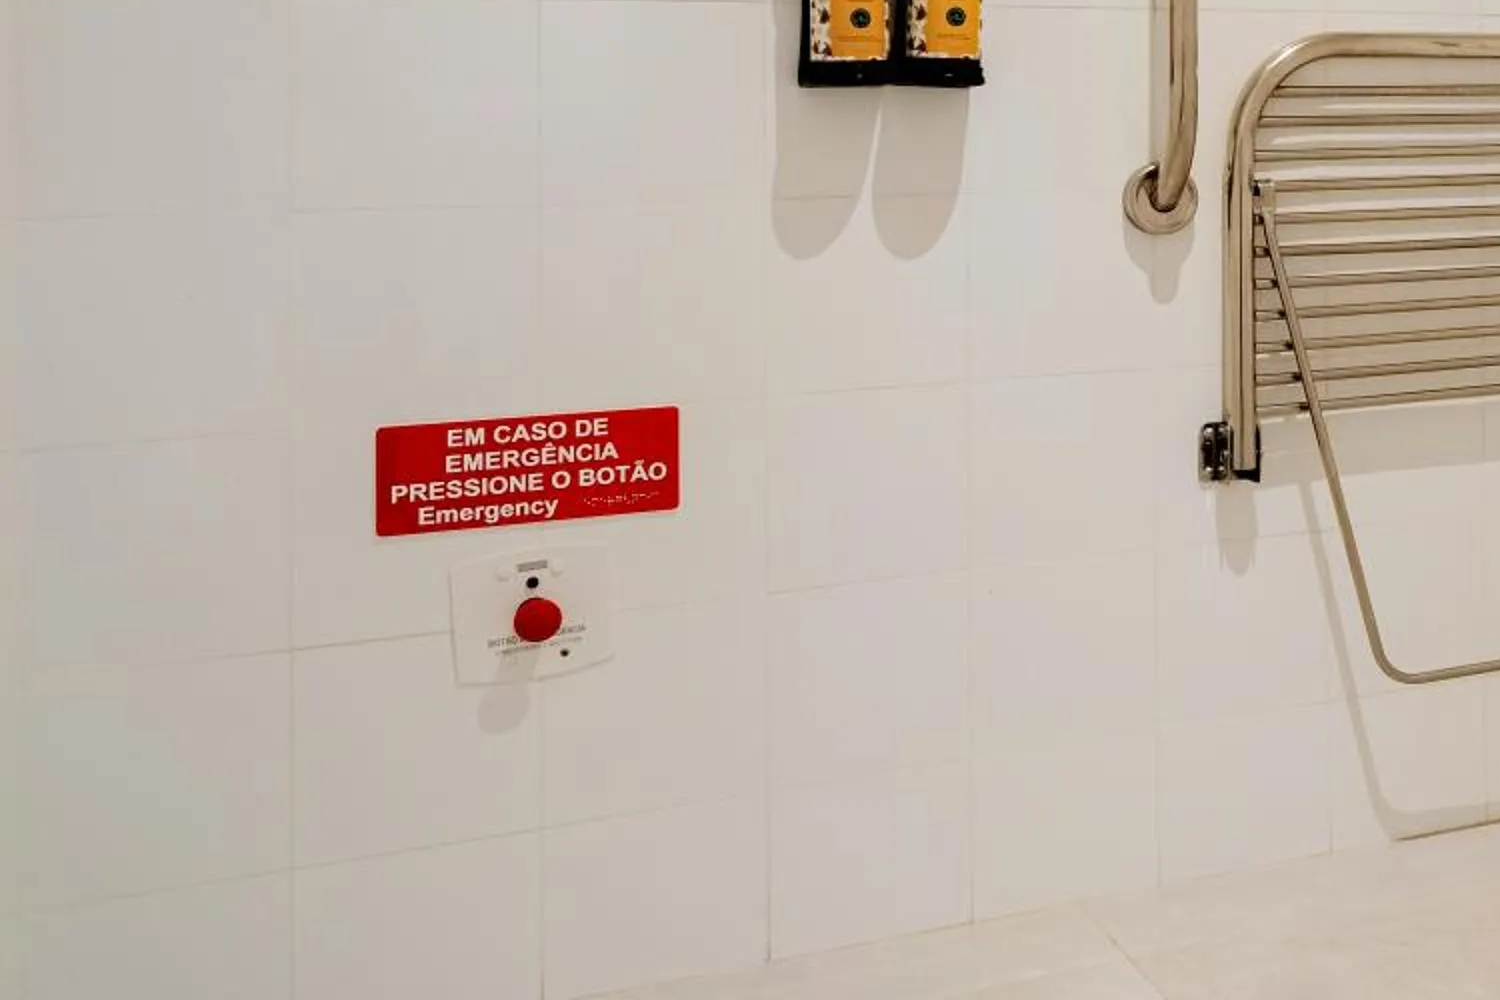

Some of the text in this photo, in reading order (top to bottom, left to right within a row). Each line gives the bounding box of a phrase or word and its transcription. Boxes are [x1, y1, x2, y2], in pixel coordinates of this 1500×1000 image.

[447, 417, 609, 448] EM CASO DE
[445, 441, 619, 473] EMERGÊNCIA
[391, 459, 667, 504] PRESSIONE O BOTÃO
[418, 499, 559, 525] Emergency
